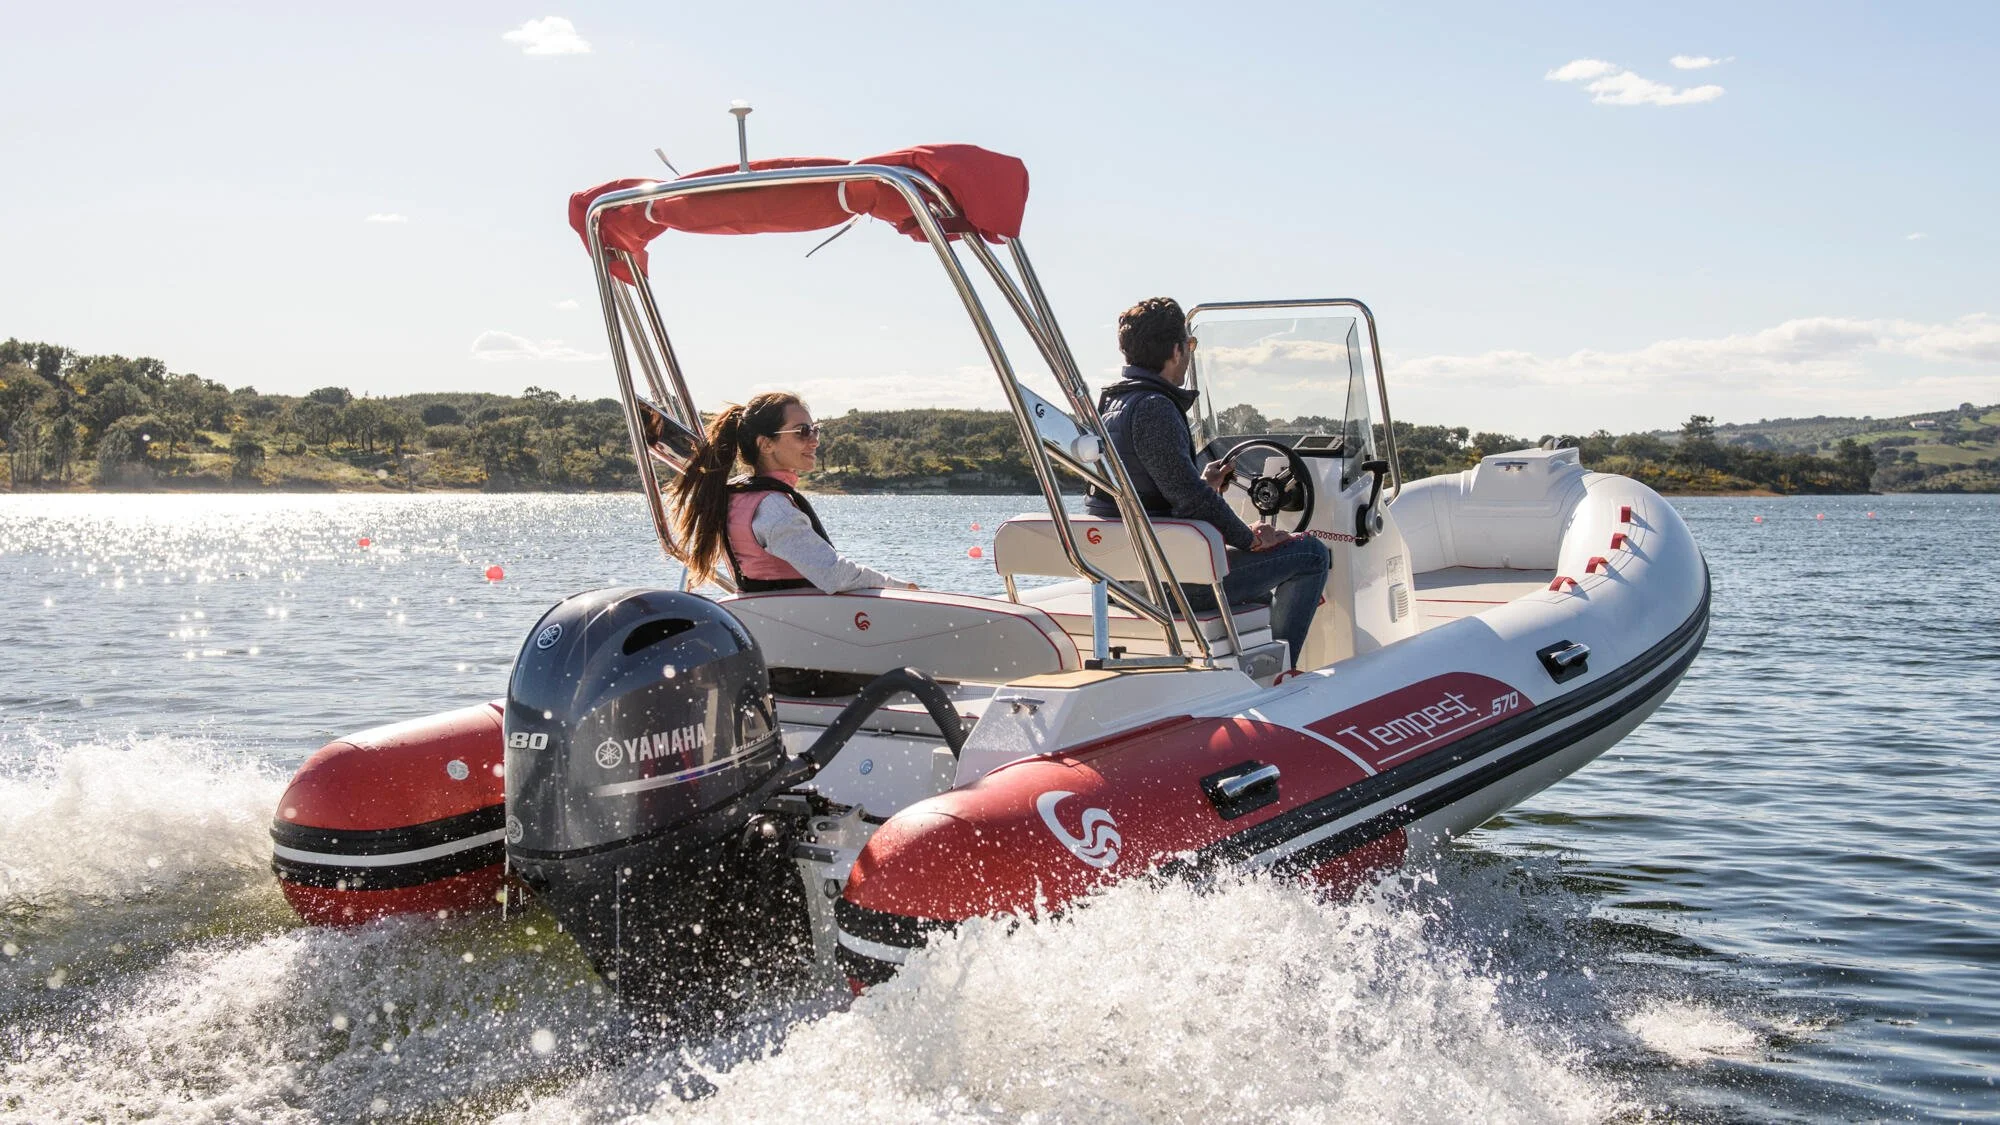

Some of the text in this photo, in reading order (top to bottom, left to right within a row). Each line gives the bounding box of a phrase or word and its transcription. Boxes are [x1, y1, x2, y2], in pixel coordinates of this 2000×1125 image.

[509, 732, 549, 750] 80
[1336, 691, 1519, 751] Tempest 570
[623, 722, 708, 763] YAMAHA
